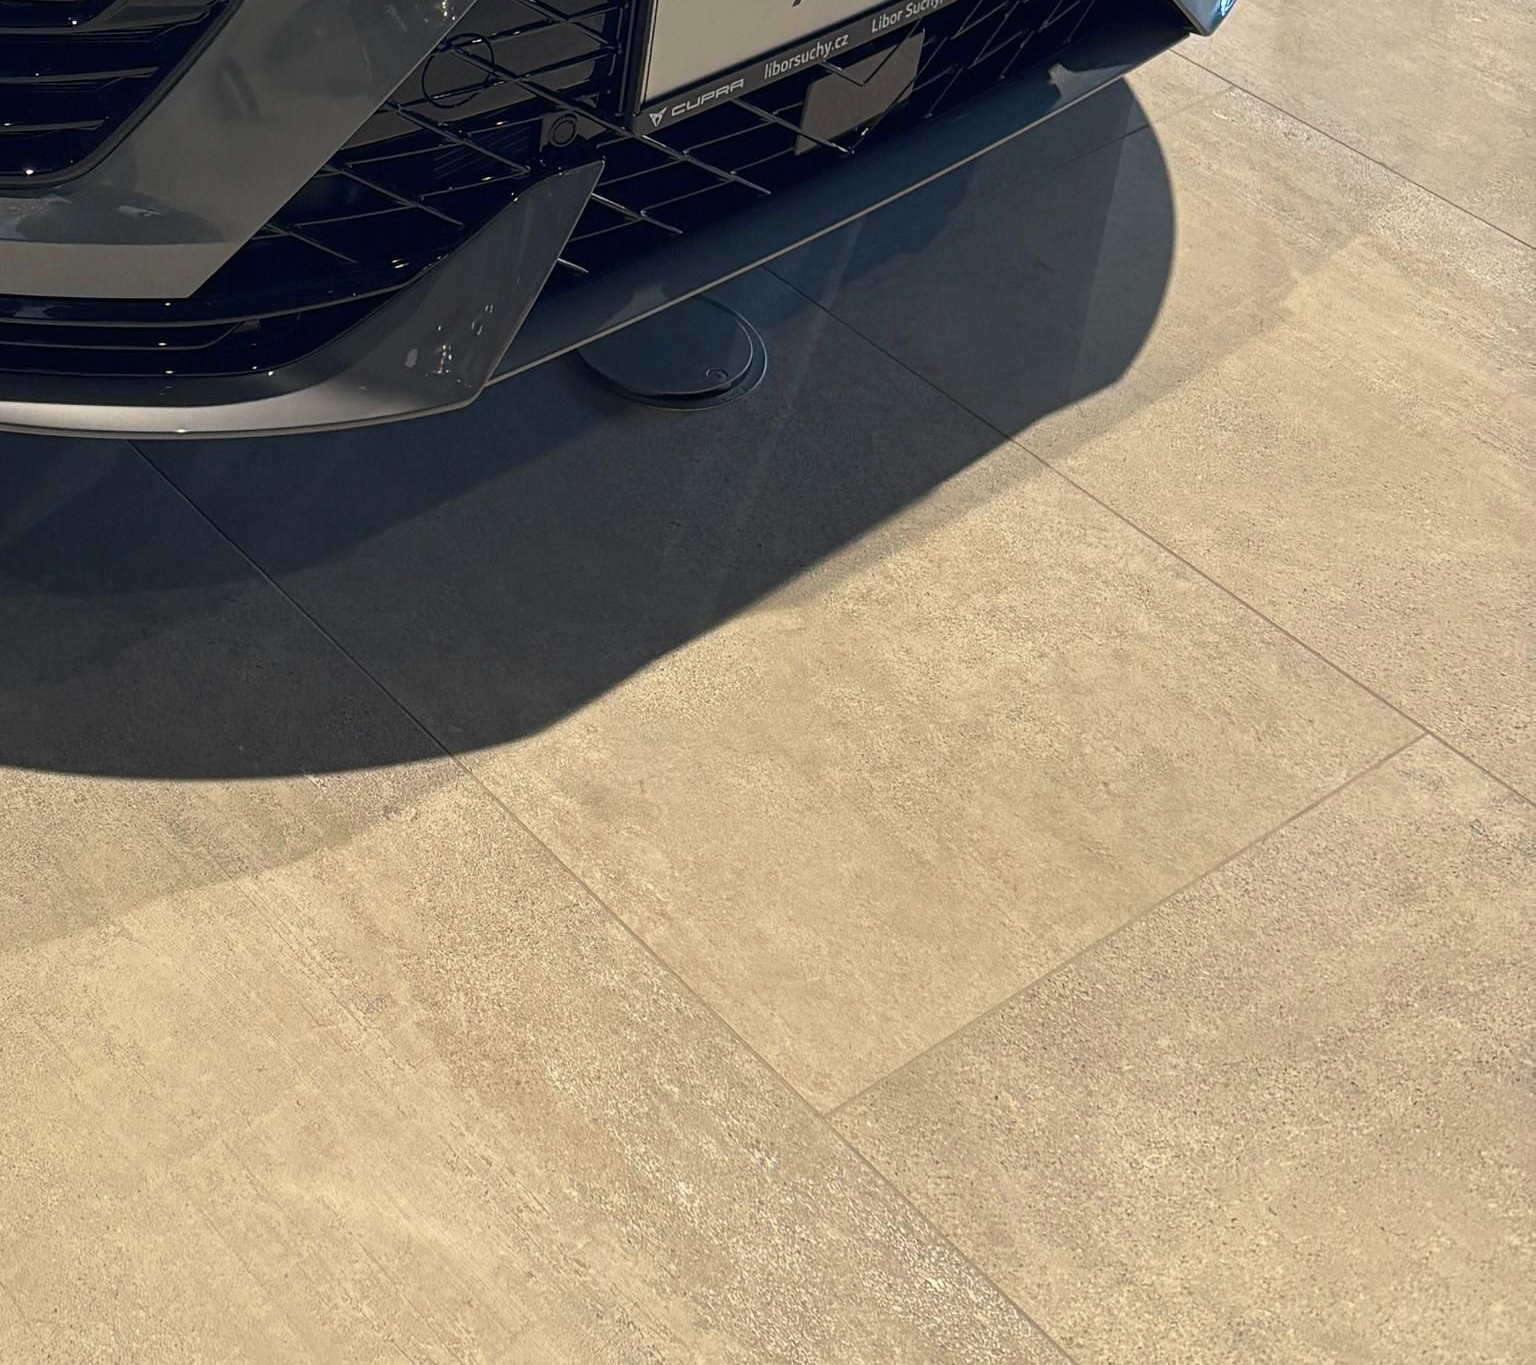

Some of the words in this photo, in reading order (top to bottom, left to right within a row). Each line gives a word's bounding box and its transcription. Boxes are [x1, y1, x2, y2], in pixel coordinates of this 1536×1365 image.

[871, 9, 903, 33] Libor
[764, 34, 849, 79] liborsuchy.cz
[671, 78, 745, 117] CUPRA
